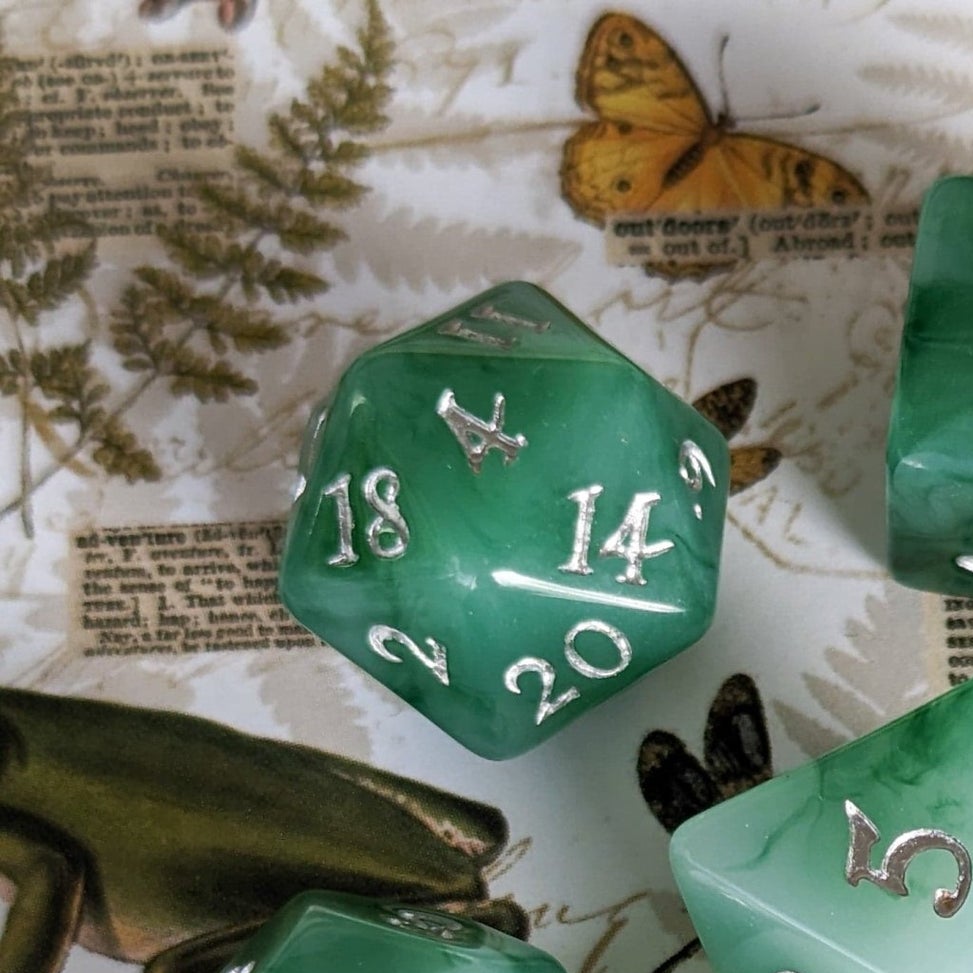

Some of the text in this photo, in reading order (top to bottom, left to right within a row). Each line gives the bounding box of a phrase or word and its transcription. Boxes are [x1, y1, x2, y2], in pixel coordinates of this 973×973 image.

[436, 387, 529, 474] 4
[324, 466, 411, 568] 18
[558, 484, 675, 586] 14
[368, 624, 450, 687] 2
[504, 619, 633, 726] 20
[845, 799, 973, 918] 5
